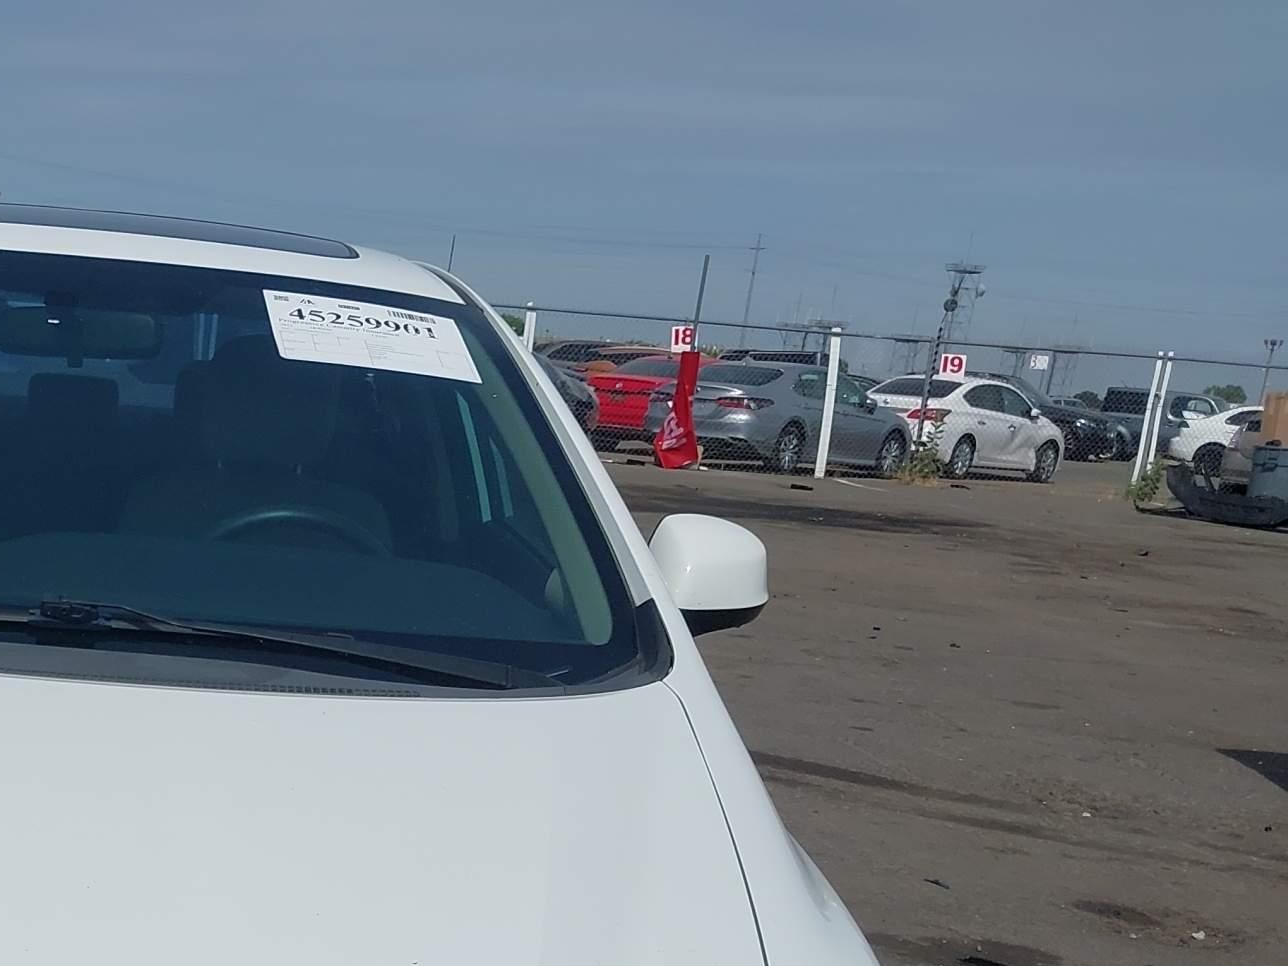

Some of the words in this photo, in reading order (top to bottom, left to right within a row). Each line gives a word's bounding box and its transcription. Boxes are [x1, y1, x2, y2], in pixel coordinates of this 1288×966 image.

[289, 308, 439, 339] 45259901
[674, 327, 694, 346] 18
[942, 355, 964, 374] 19
